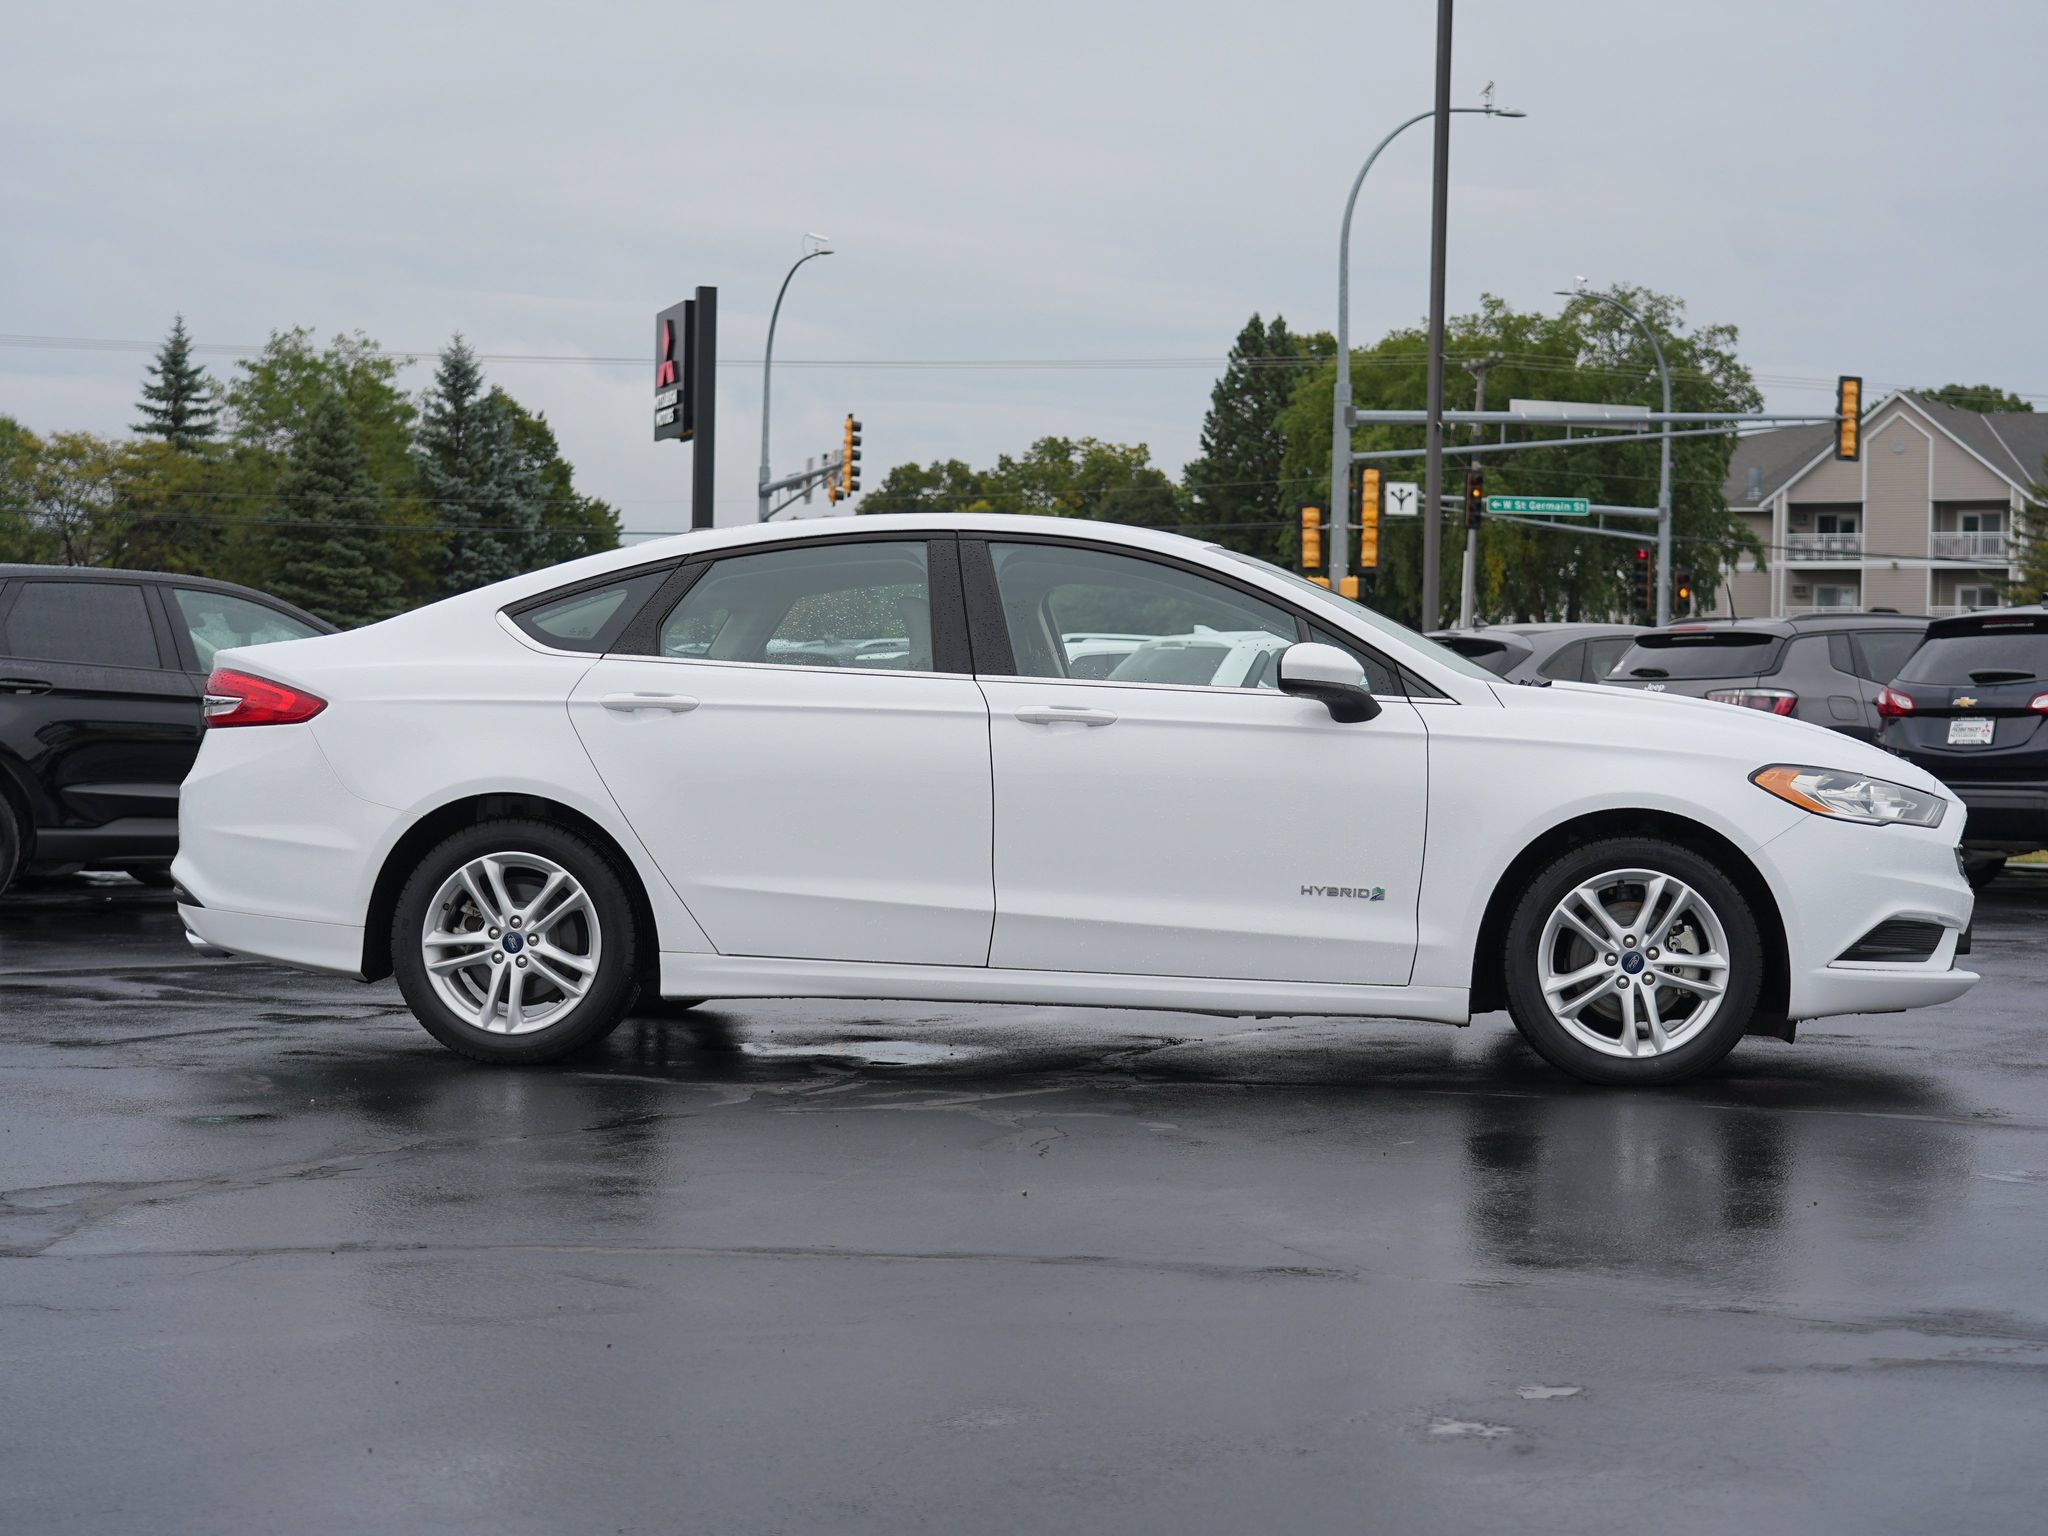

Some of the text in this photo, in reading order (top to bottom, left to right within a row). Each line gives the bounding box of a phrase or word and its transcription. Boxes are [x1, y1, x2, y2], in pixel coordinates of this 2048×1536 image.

[1502, 501, 1585, 512] W St Germain St
[1644, 683, 1665, 692] Jeep
[1300, 885, 1370, 899] HYBRID
